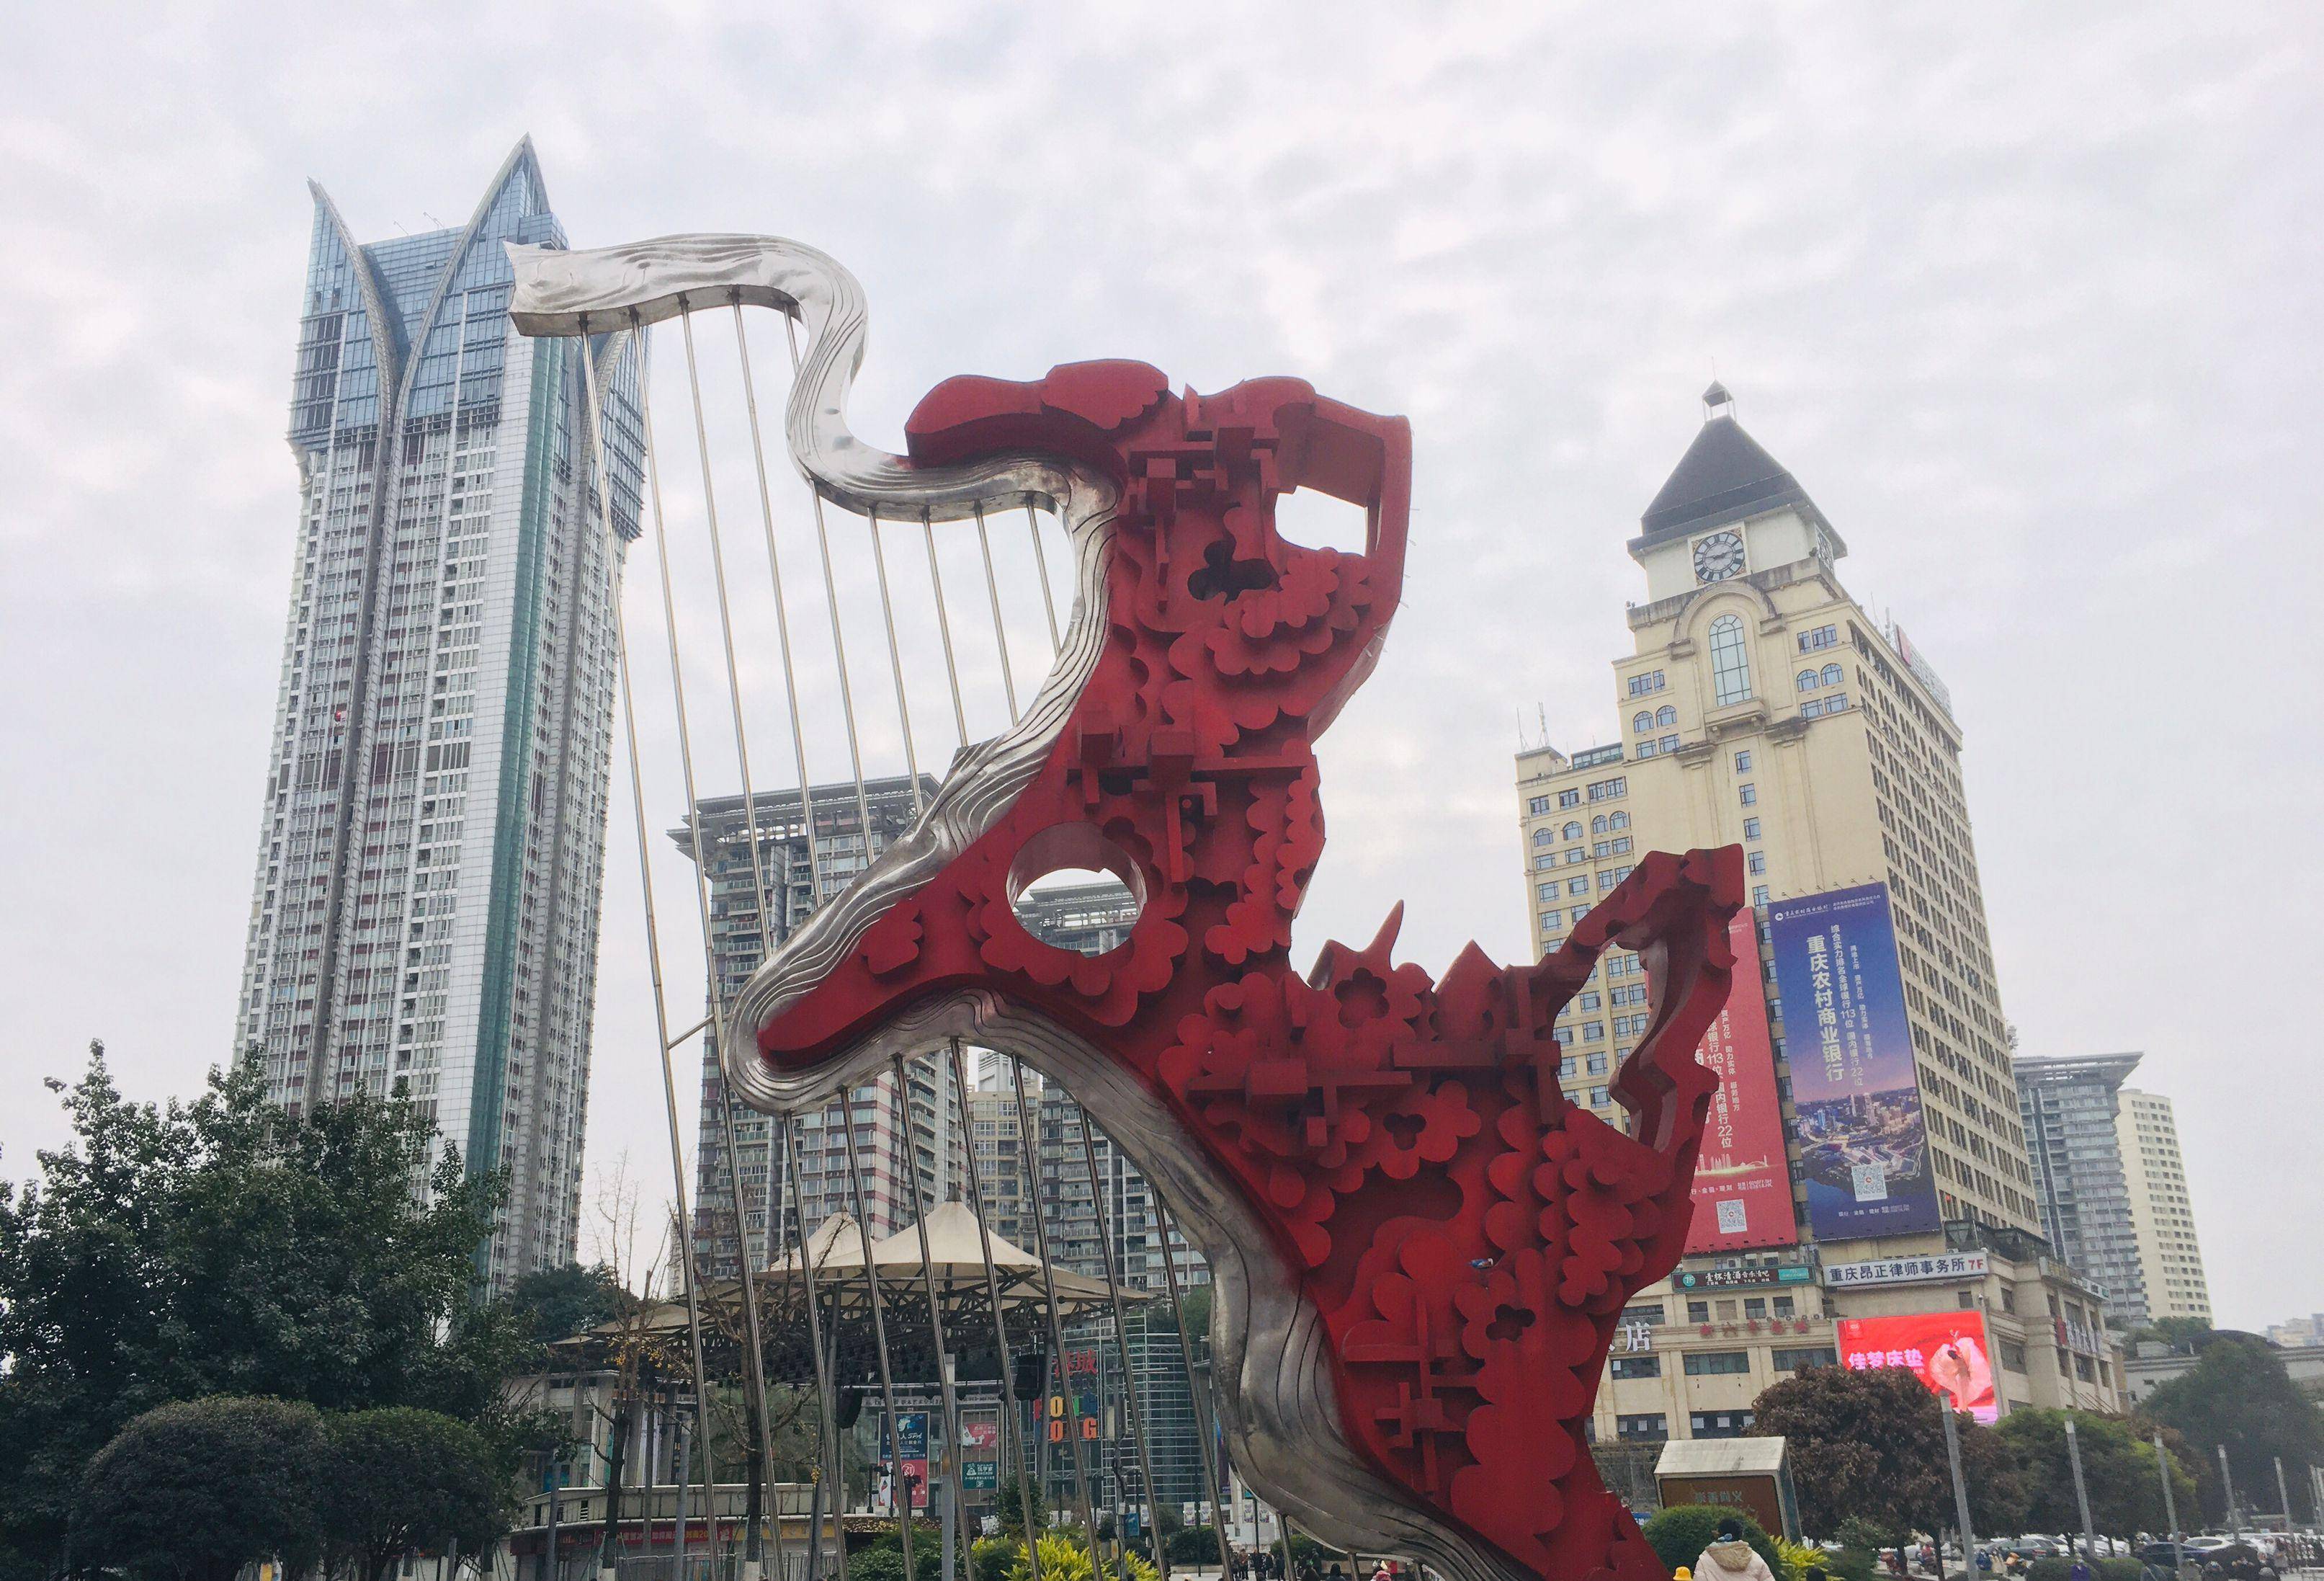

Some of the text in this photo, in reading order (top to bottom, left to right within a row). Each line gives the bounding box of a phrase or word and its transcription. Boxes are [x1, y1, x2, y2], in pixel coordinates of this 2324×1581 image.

[1807, 935, 1844, 1082] 重庆农村商业银行
[1829, 1258, 1965, 1282] 重庆昂正律师事务所
[1968, 1259, 1983, 1270] 7F
[1849, 1348, 1924, 1370] 佳梦床垫
